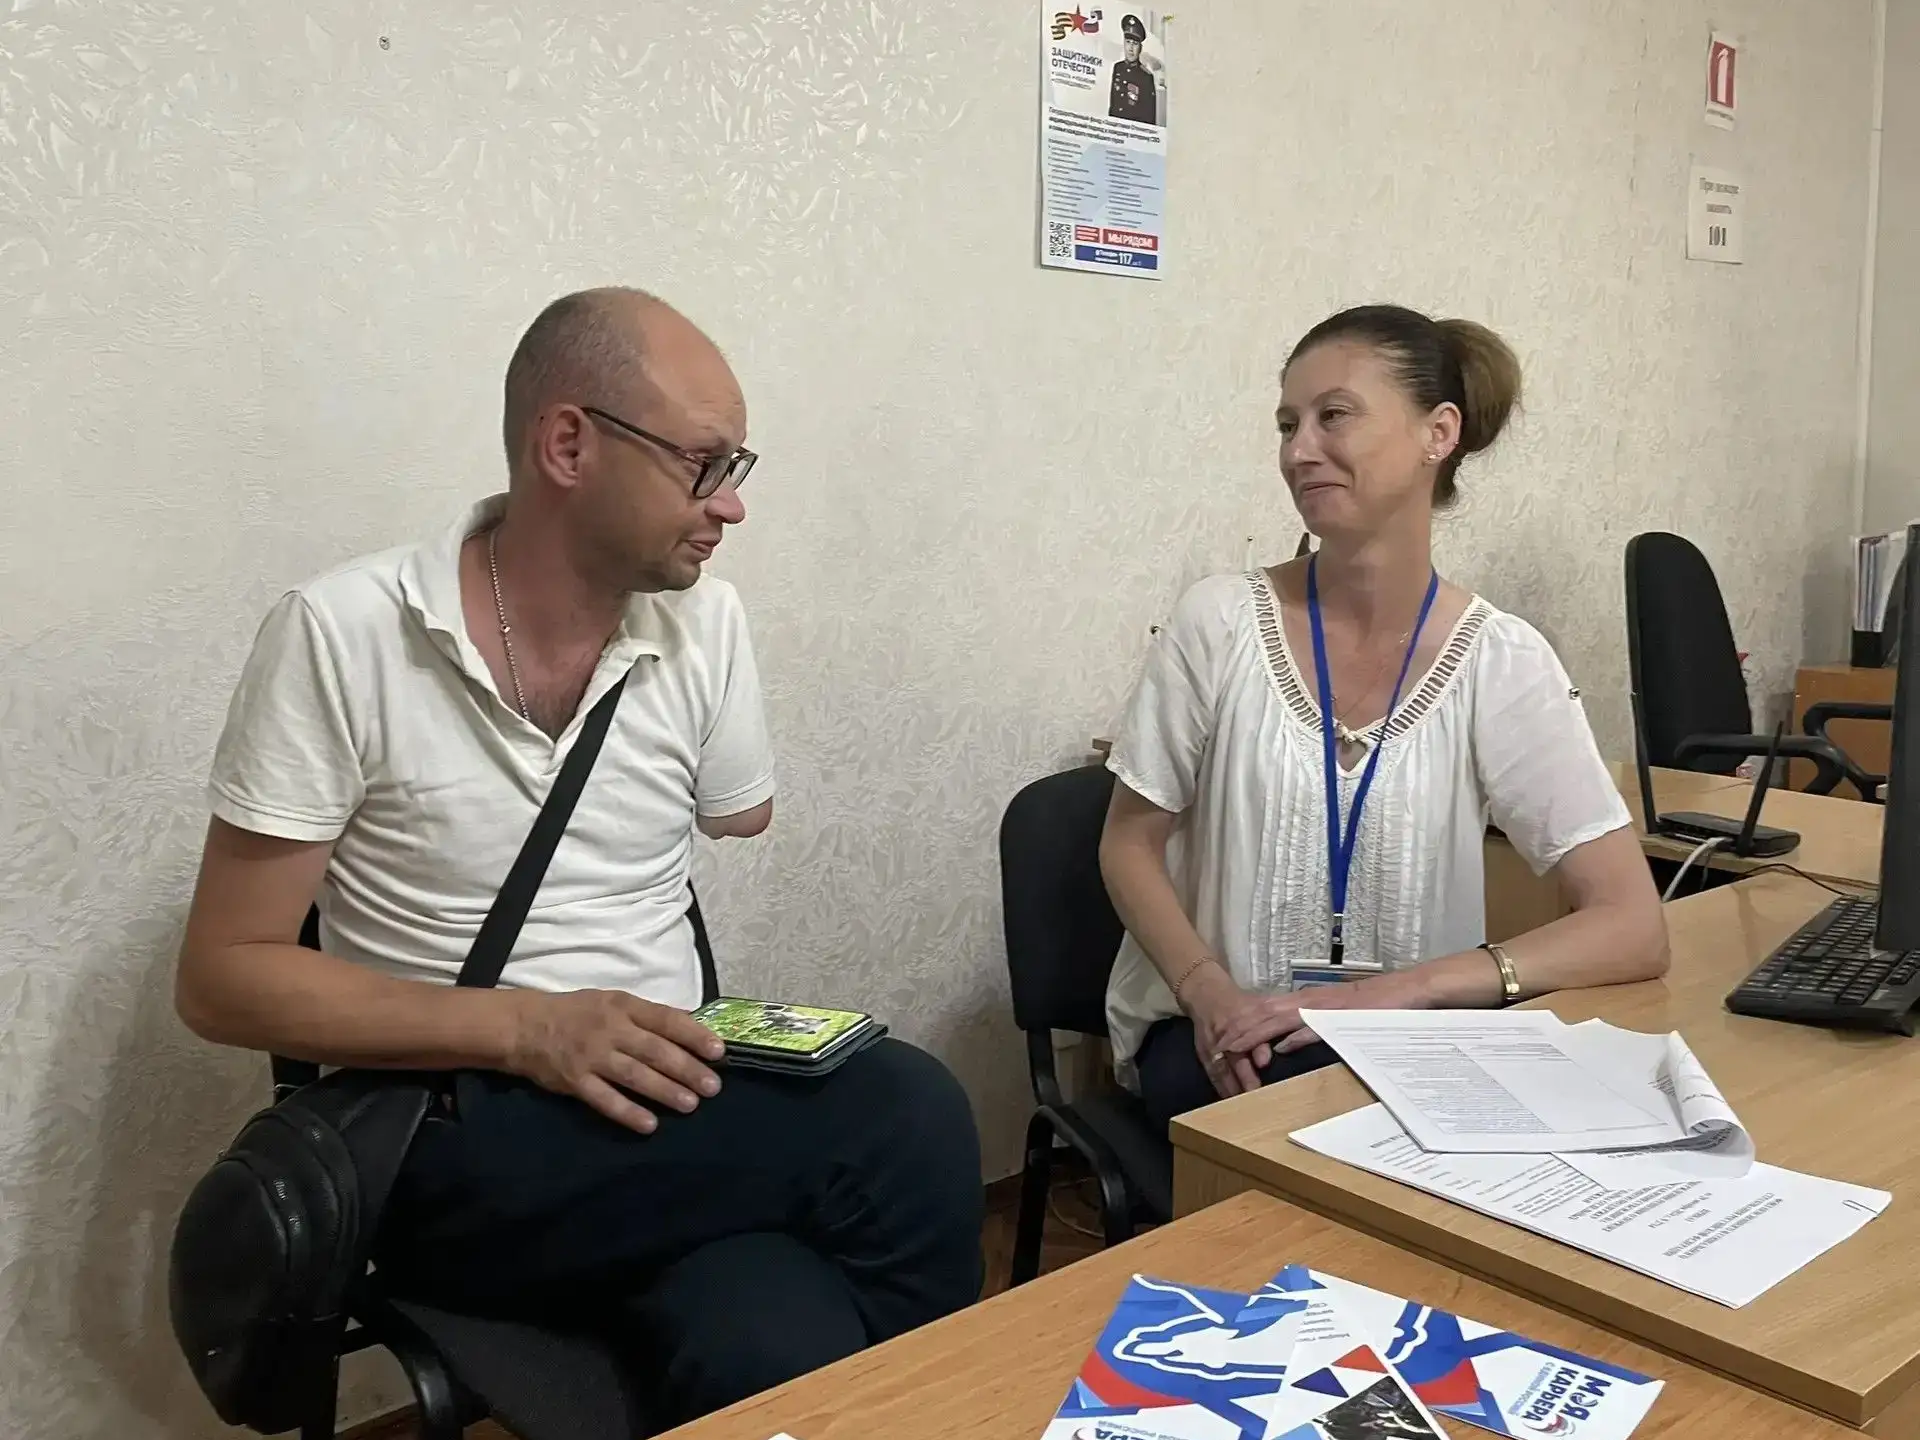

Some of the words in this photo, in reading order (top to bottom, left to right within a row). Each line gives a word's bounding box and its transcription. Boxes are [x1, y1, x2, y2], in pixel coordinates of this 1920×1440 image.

[1051, 47, 1103, 67] ЗАЩИТНИКИ
[1051, 58, 1096, 76] ОТЕЧЕСТВА
[1709, 226, 1727, 246] 101
[1118, 252, 1133, 264] 117
[1521, 1366, 1579, 1421] КАРЬЕРА
[1559, 1374, 1612, 1420] МОЯ
